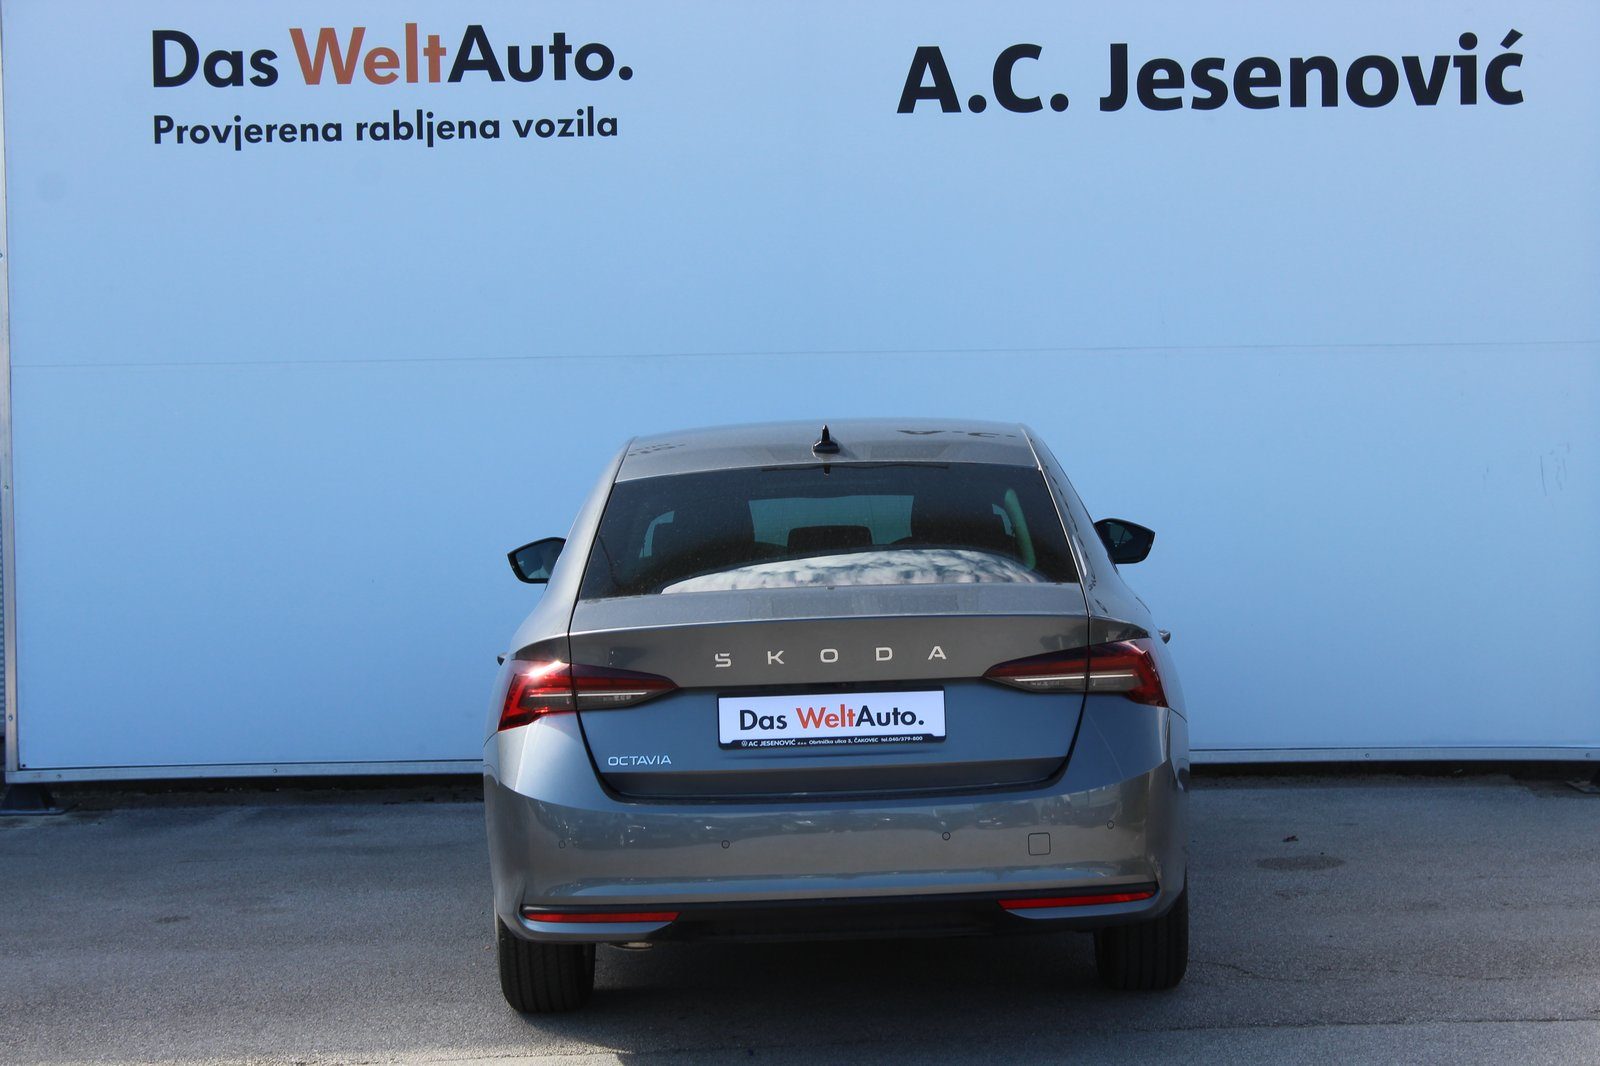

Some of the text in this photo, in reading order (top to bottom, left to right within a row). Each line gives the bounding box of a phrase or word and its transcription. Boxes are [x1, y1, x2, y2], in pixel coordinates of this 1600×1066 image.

[152, 22, 634, 88] Das WeltAuto.
[897, 28, 1524, 114] A.C. Jesenović
[153, 106, 619, 151] Provjerena rabljena vozila
[739, 703, 925, 731] Das WeltAuto.
[608, 755, 672, 766] OCTAVIA
[759, 739, 796, 747] JESENOVIĆ
